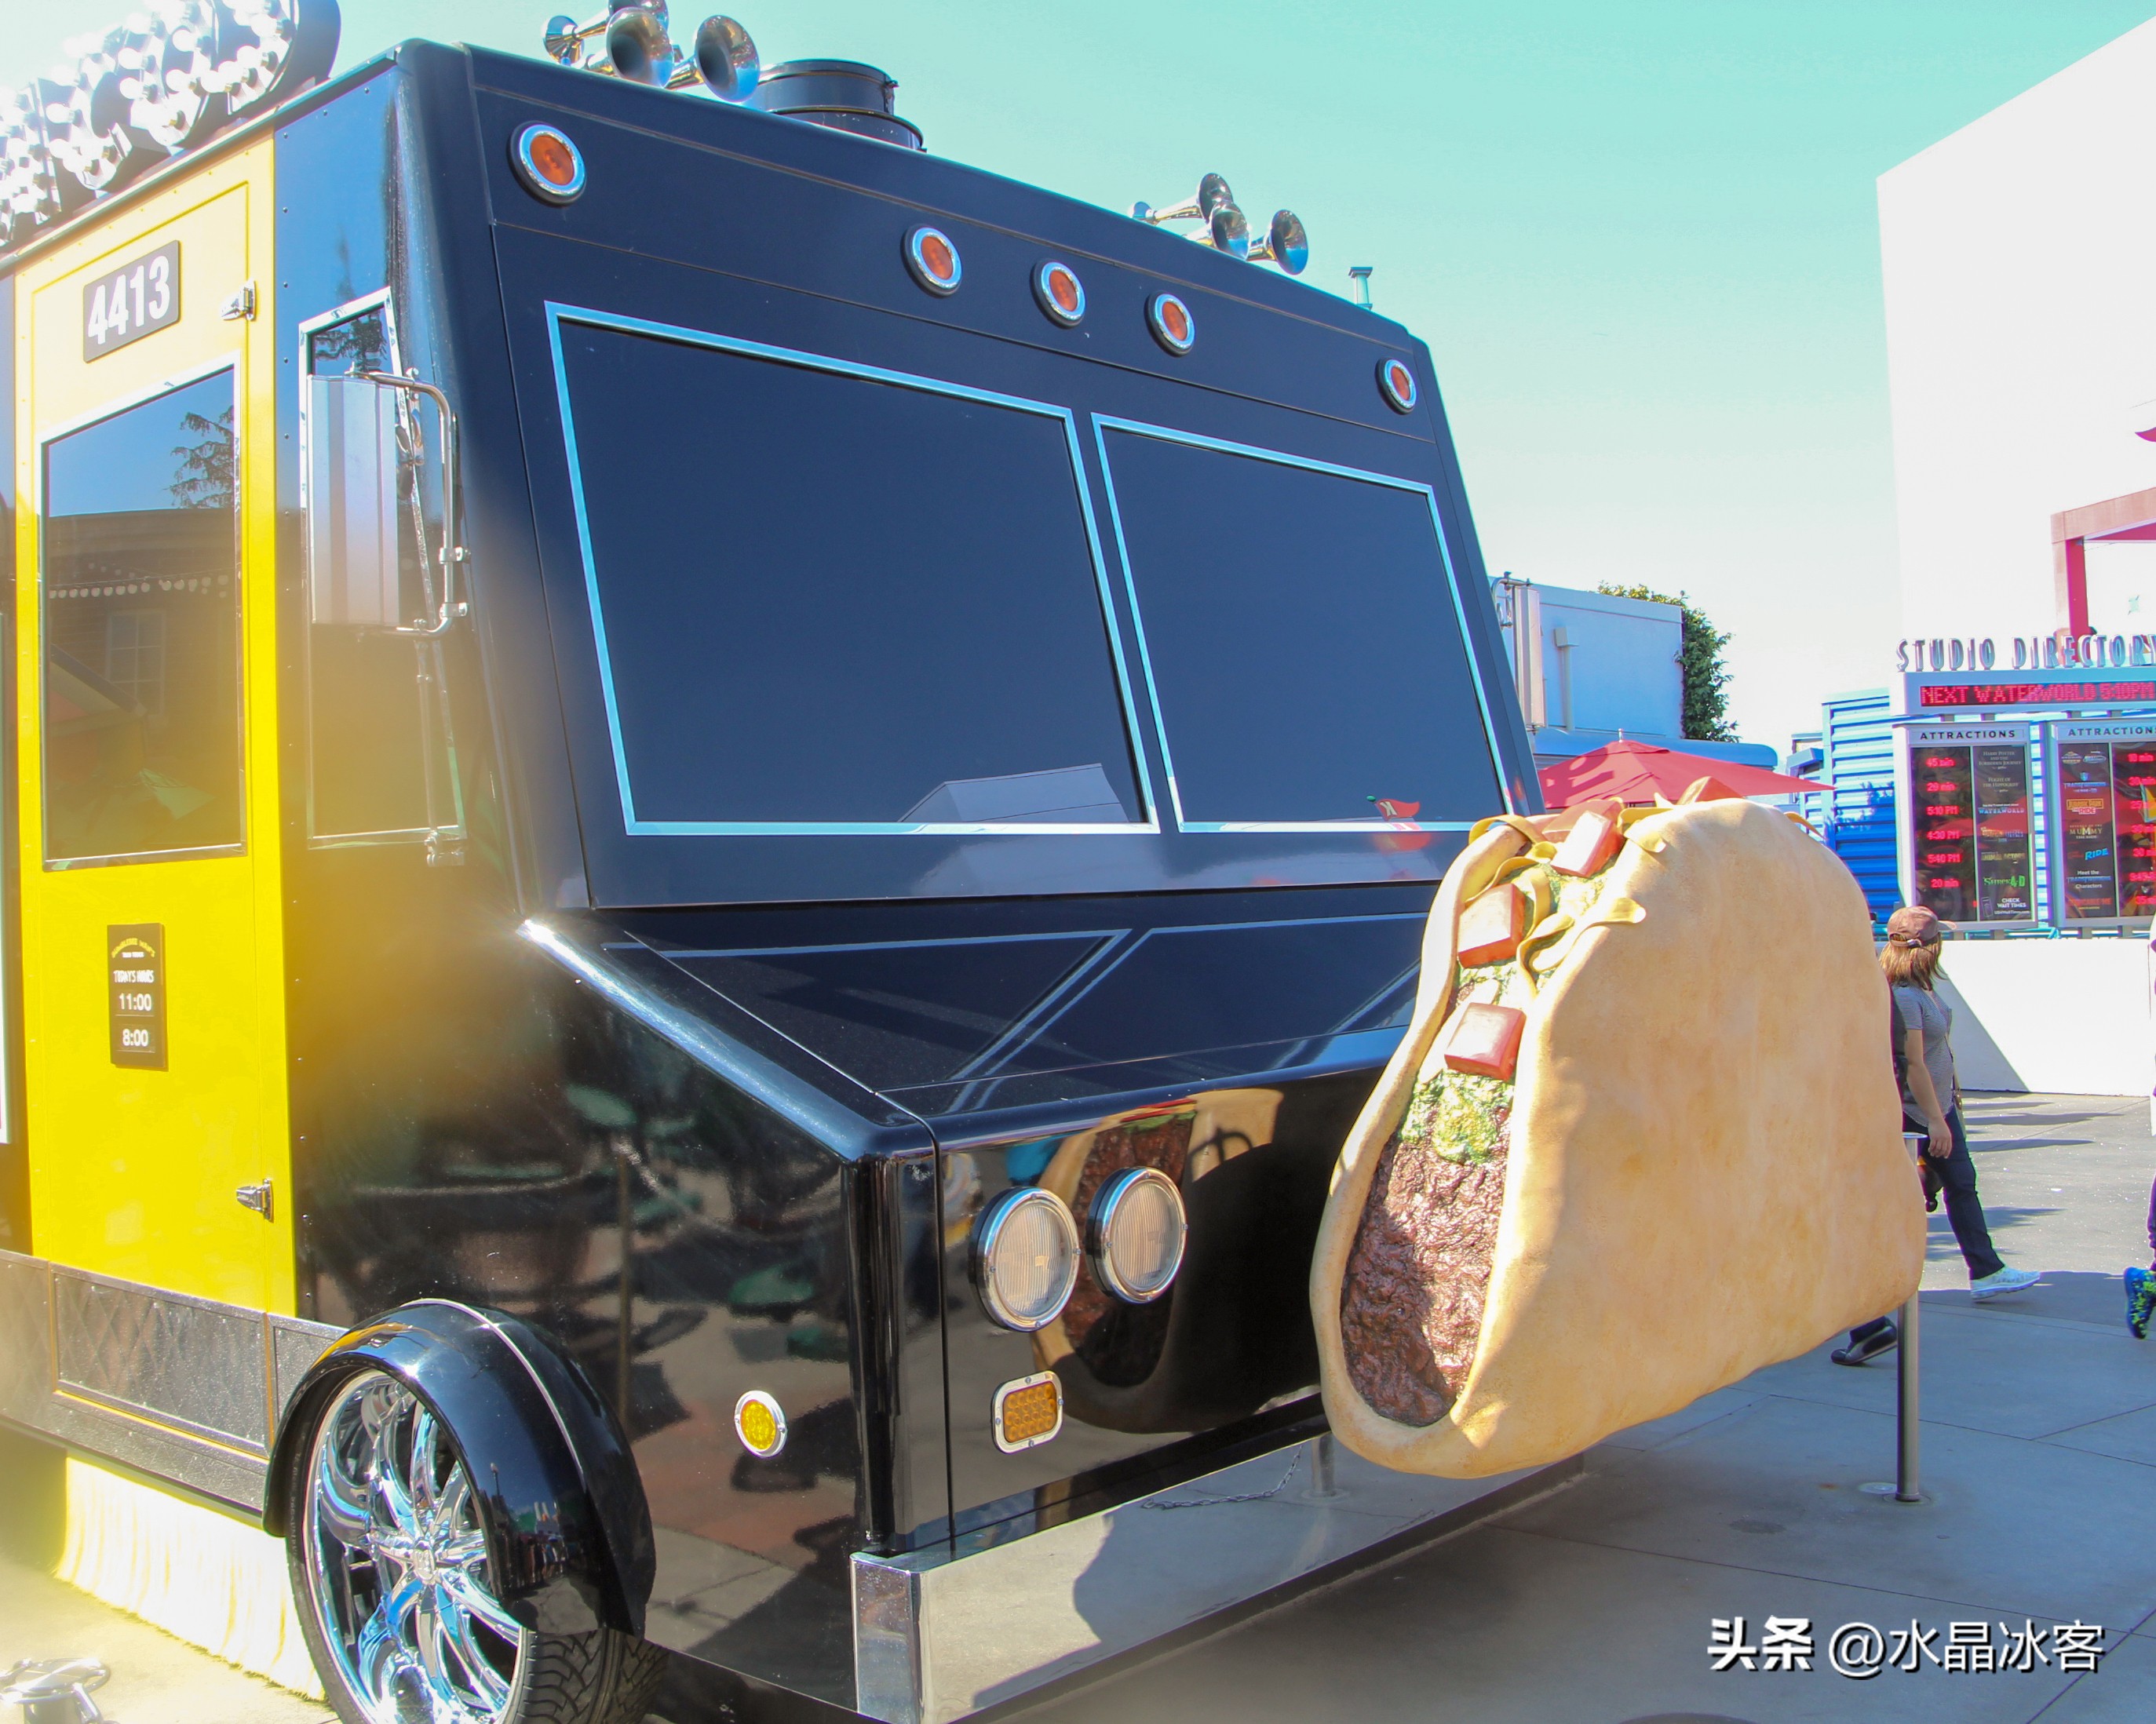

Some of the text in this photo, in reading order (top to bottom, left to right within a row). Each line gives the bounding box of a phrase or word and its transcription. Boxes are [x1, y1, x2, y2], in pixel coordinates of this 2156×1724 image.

[88, 255, 170, 344] 4413
[1896, 637, 1995, 672] STUDIO
[1921, 687, 1968, 704] NEXT
[1974, 683, 2096, 703] WATERWORLD
[1920, 730, 2016, 740] ATTRACTIONS
[1926, 756, 1956, 767] 45 min
[1940, 782, 1957, 791] min
[1926, 805, 1960, 815] 5:10 PM
[1927, 830, 1961, 840] 4:30 PM
[2070, 827, 2103, 836] MUMMY
[1927, 853, 1962, 863] 5:40 PM
[2085, 847, 2109, 860] RIDE
[1931, 878, 1960, 888] 20 min
[119, 993, 151, 1011] 11:00
[122, 1028, 148, 1047] 8:00
